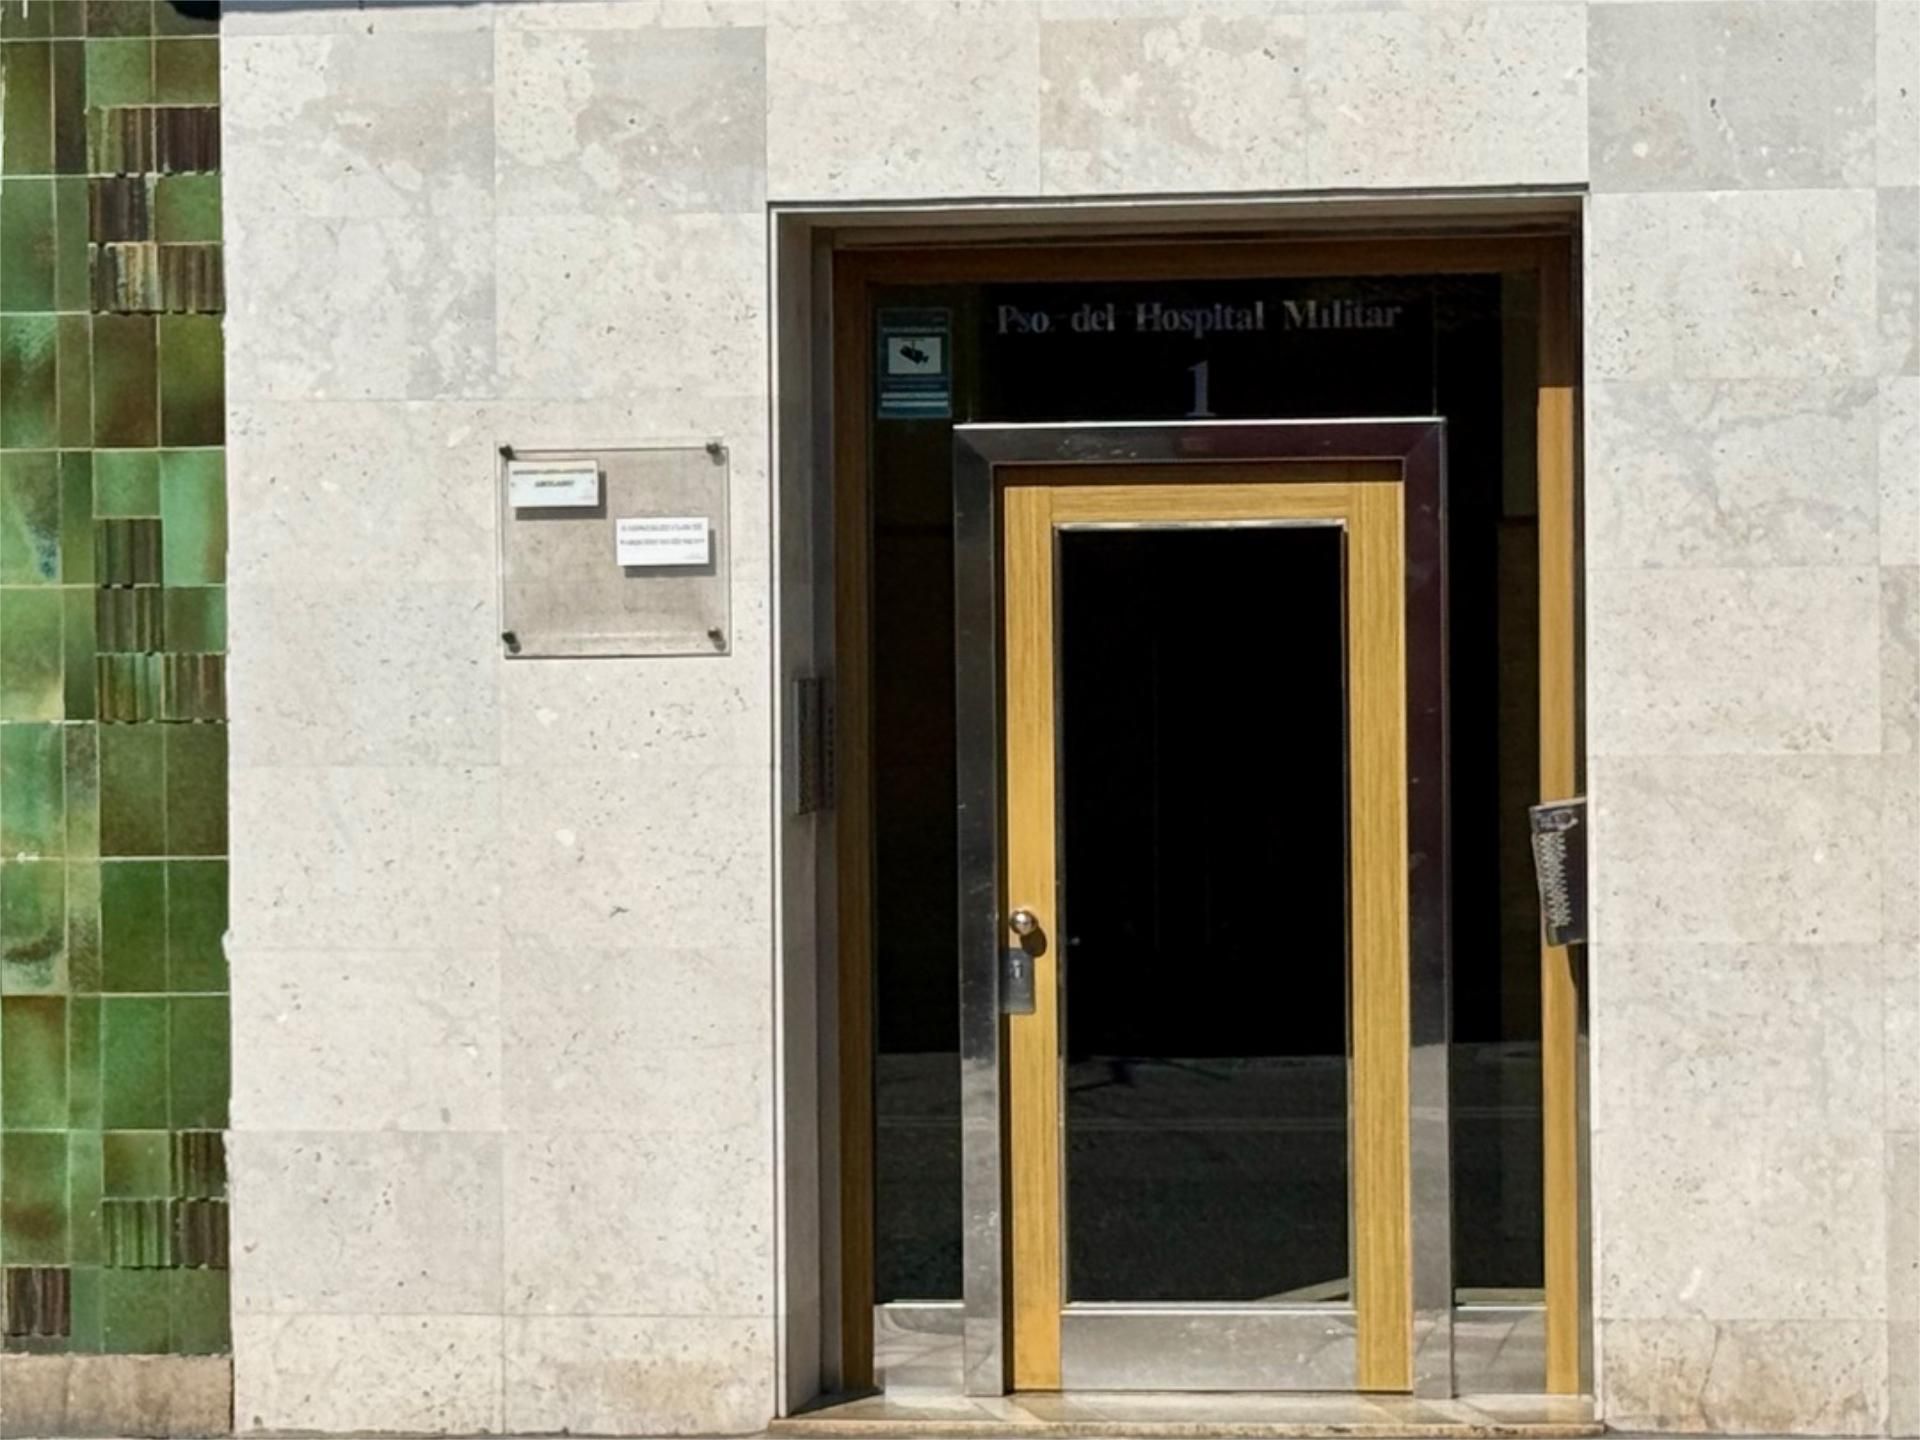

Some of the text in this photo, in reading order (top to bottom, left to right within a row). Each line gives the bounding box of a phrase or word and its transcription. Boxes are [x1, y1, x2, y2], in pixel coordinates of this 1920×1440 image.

[998, 300, 1403, 339] Pso. del Hospital Militar
[1186, 360, 1216, 417] 1
